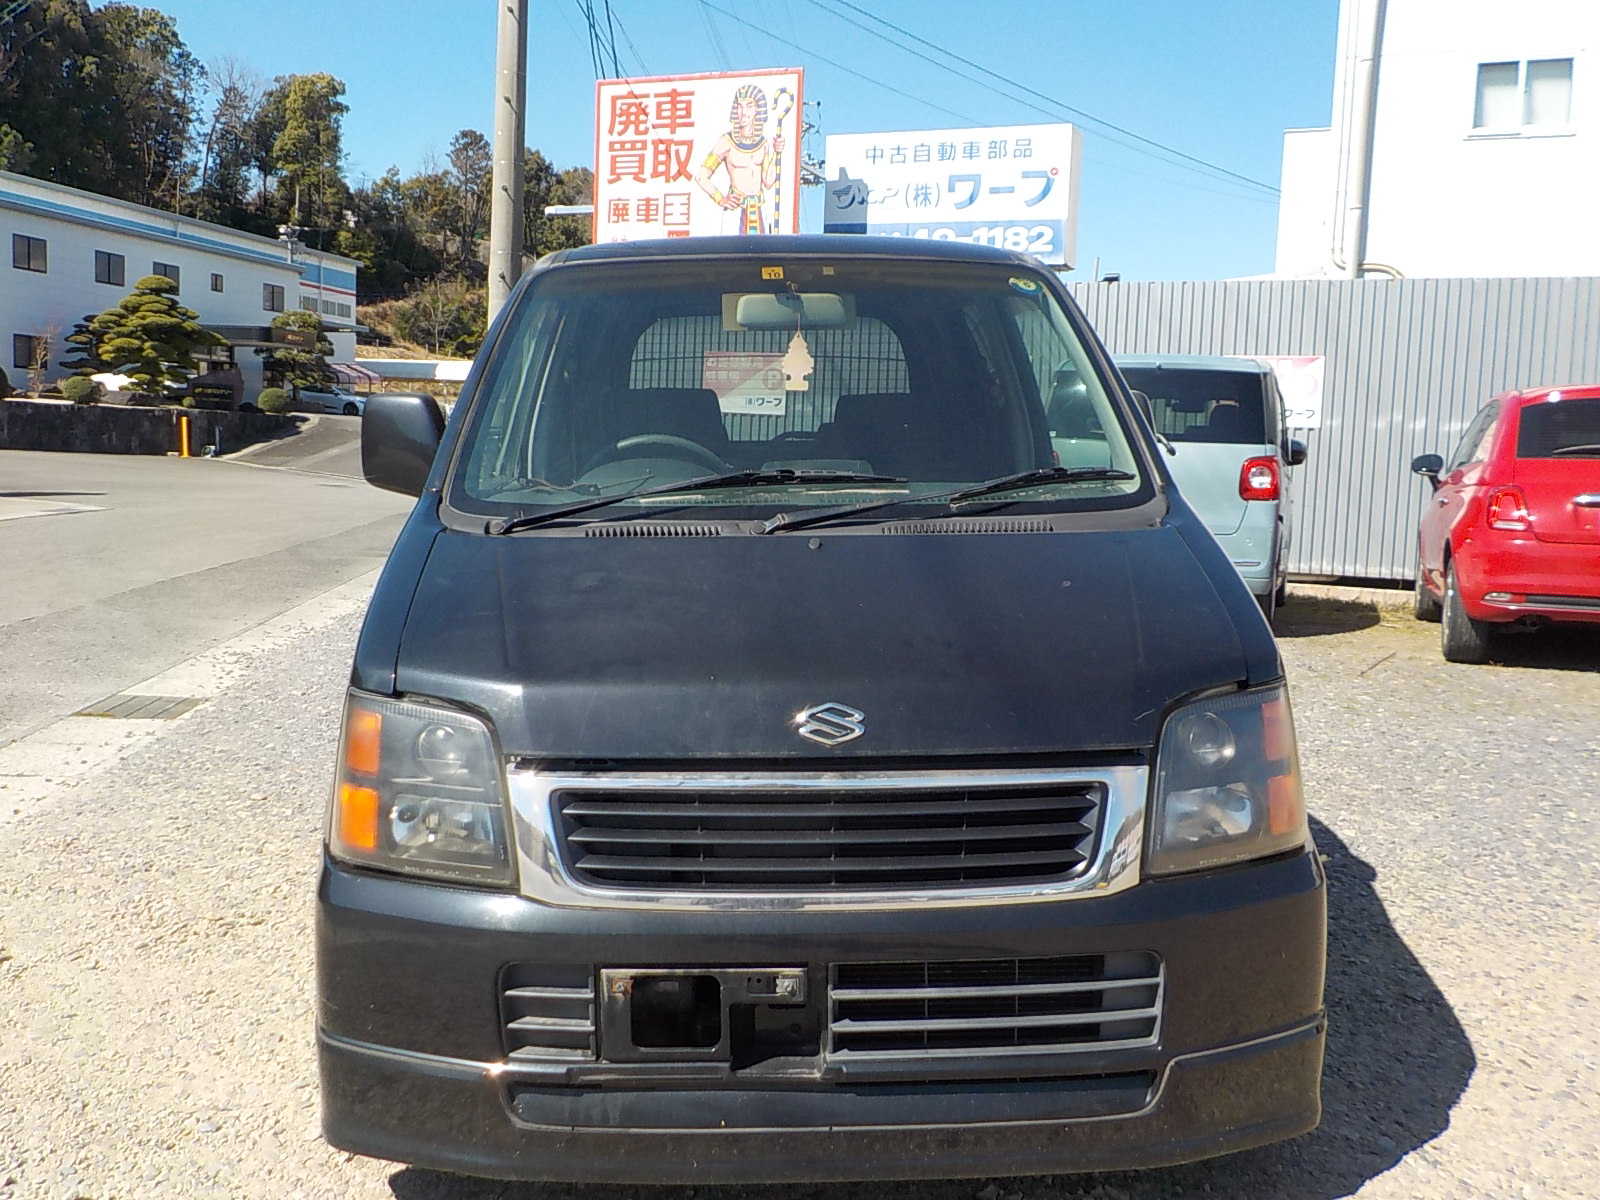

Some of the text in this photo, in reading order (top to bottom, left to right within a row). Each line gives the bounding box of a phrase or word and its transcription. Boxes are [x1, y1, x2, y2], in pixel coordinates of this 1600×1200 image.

[608, 88, 695, 136] 廃車
[607, 138, 694, 184] 買取
[865, 138, 1033, 164] 中古自動車部品
